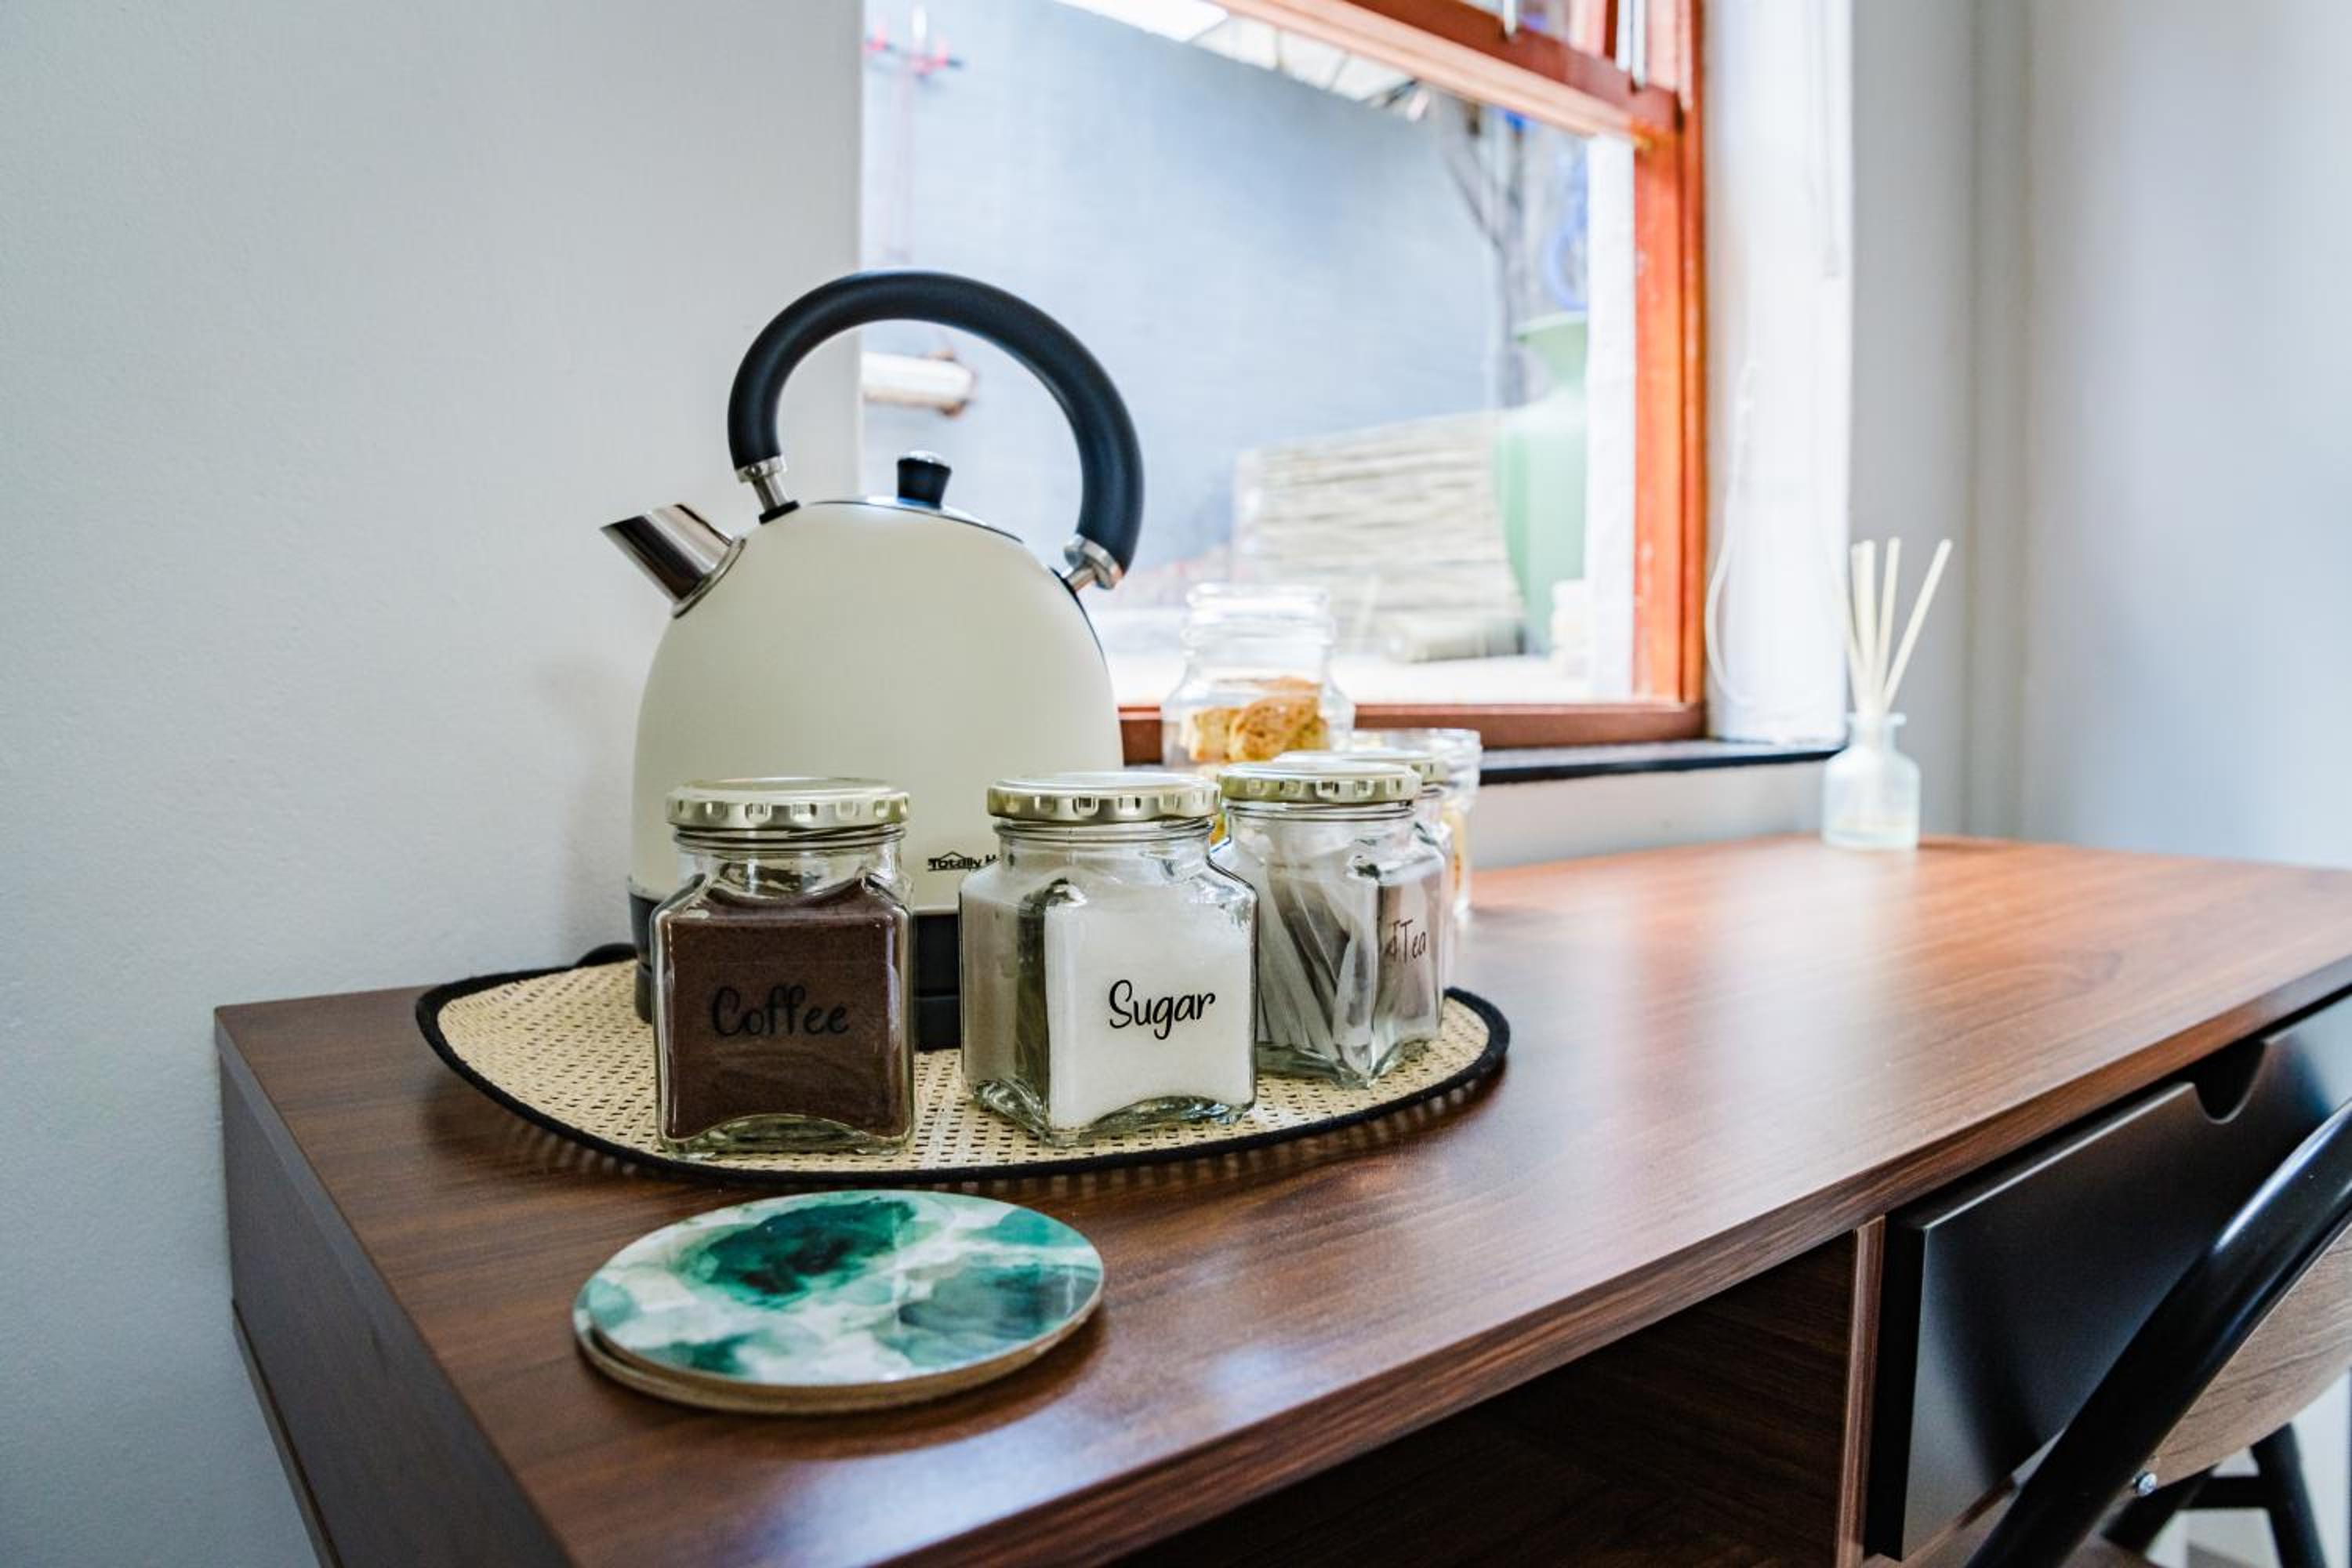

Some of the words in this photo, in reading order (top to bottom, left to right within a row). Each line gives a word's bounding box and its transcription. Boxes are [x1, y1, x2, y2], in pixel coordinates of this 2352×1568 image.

[927, 857, 982, 871] Totally
[712, 985, 850, 1038] Coffee
[1109, 979, 1216, 1040] Sugar
